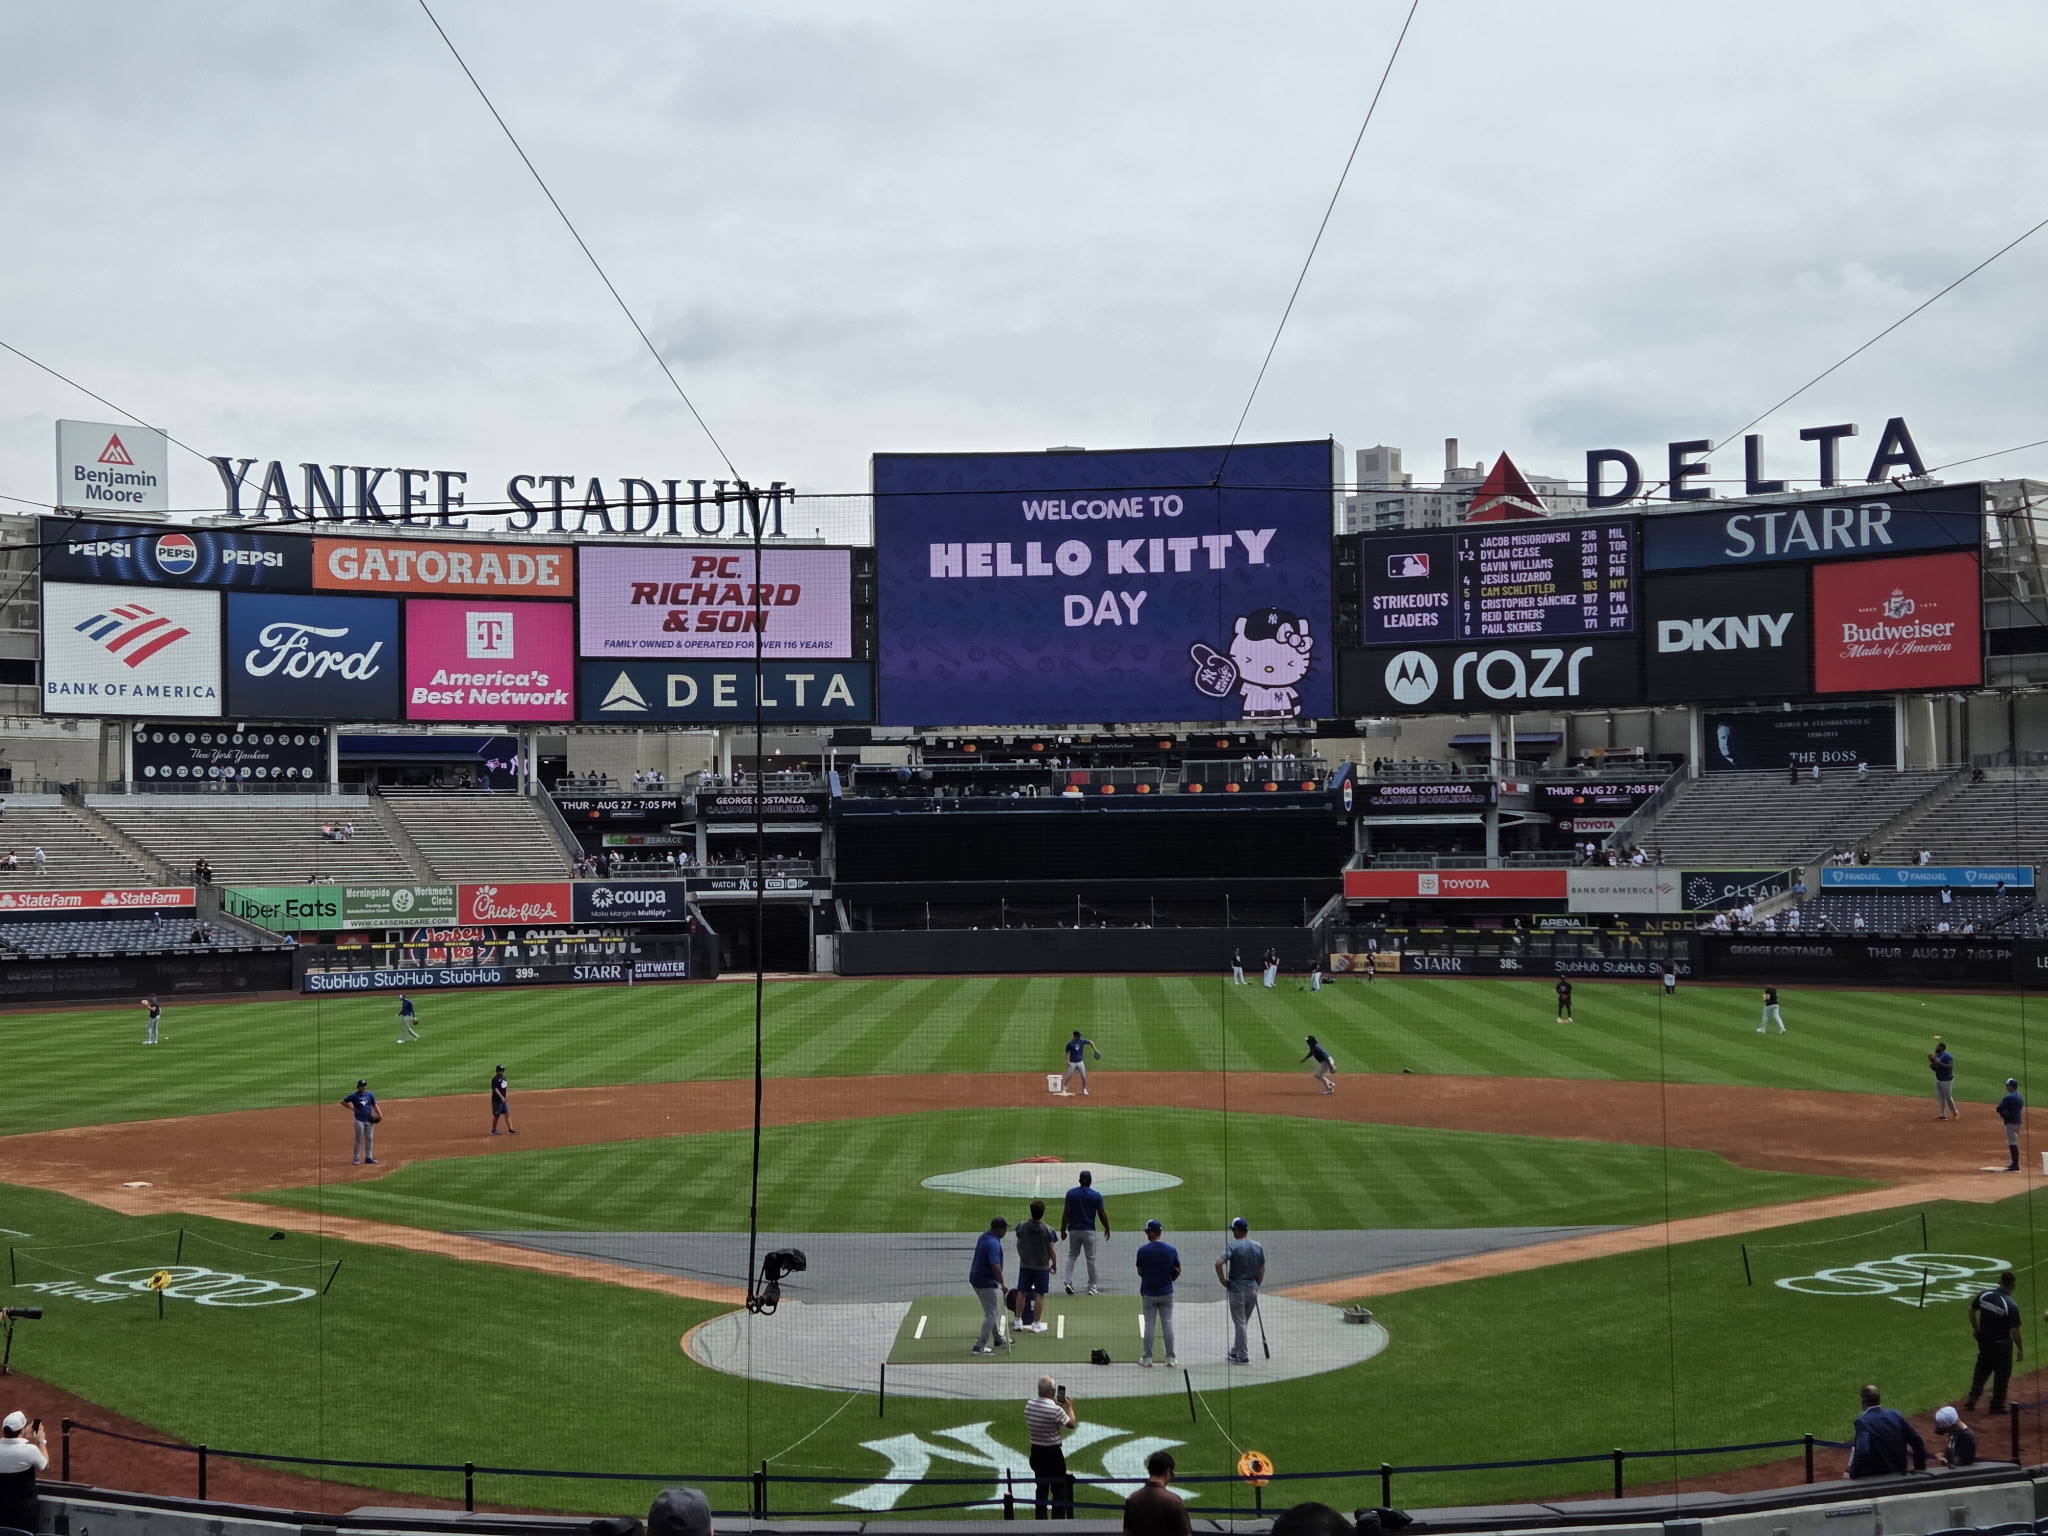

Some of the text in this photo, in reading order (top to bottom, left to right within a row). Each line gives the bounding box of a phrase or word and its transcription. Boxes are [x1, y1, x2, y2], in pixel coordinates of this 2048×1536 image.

[1587, 416, 1925, 508] DELTA
[75, 465, 157, 488] Benjamin
[85, 485, 143, 503] Moore
[207, 457, 787, 537] YANKEE STADIUM
[1022, 494, 1183, 521] WELCOME TO
[1464, 528, 1624, 549] 1 JACOB MISIOROWSKI 216 MIL
[1725, 504, 1892, 558] STARR
[69, 540, 131, 558] PEPSI
[157, 547, 195, 560] PEPSI
[222, 549, 283, 567] PEPSI
[930, 528, 1277, 578] HELLO KITTY
[1458, 541, 1627, 561] T-2 DYLAN CEASE 201 TOR
[329, 548, 560, 587] GATORADE
[691, 556, 741, 579] P.C.
[1481, 553, 1626, 573] GAVIN WILLIAMS 201 CLE
[1463, 566, 1625, 586] 4 JESÚS LUZARDO 194 PHI
[631, 583, 801, 606] RICHARD
[1464, 578, 1628, 598] 5 CAM SCHLITTLER 193 NYY
[1064, 590, 1147, 627] DAY
[1373, 593, 1448, 610] STRIKEOUTS
[1464, 591, 1625, 610] 6 CRISTOPHER SÁNCHEZ 187 PHI
[662, 610, 769, 633] & SON
[1384, 613, 1439, 628] LEADERS
[1464, 604, 1628, 623] 7 REID DETMERS 172 LAA
[1464, 616, 1625, 635] 8 PAUL SKENES 171 PIT
[1658, 613, 1794, 654] DKNY
[1842, 620, 1955, 643] Budweiser
[245, 622, 385, 680] Ford
[604, 639, 833, 650] FAMILY OWNED & OPERATED FOR VER 116 YEARS!
[1840, 640, 1952, 659] Made of America
[430, 669, 549, 688] America's
[1453, 646, 1593, 698] razr
[48, 681, 216, 699] BANK OF AMERICA
[412, 686, 569, 706] Best Network
[667, 674, 855, 707] DELTA
[190, 748, 269, 764] New York Yankees
[1790, 751, 1857, 763] THE BOSS
[1380, 785, 1472, 795] GEORGE COSTANZA
[1546, 787, 1574, 795] THUR
[1582, 786, 1603, 794] AUG
[1606, 786, 1617, 794] 27
[1625, 786, 1646, 794] 7:05
[562, 801, 589, 809] THUR
[597, 801, 618, 809] AUG
[620, 801, 632, 809] 27
[1575, 821, 1615, 829] TOYOTA
[1443, 879, 1489, 890] TOYOTA
[1724, 885, 1781, 897] CLEAR
[473, 893, 558, 920] Chick-fil-A
[614, 890, 666, 907] coupa
[230, 900, 280, 918] Uber
[286, 900, 337, 918] Eats
[1541, 918, 1580, 927] ARENA
[1730, 945, 1833, 956] GEORGE COSTANZA
[1867, 947, 1901, 958] THUR
[1911, 948, 1939, 959] AUG
[1942, 949, 1957, 959] 27
[1967, 949, 1993, 960] 7:05
[574, 965, 621, 979] STARR
[635, 961, 685, 972] CUTWATER
[1414, 956, 1462, 971] STARR
[1500, 959, 1517, 970] 385
[1555, 960, 1600, 972] StubHub
[1603, 961, 1645, 974] StubHub
[310, 972, 369, 990] StubHub
[374, 970, 434, 987] StubHub
[440, 969, 500, 983] StubHub
[516, 968, 534, 979] 399
